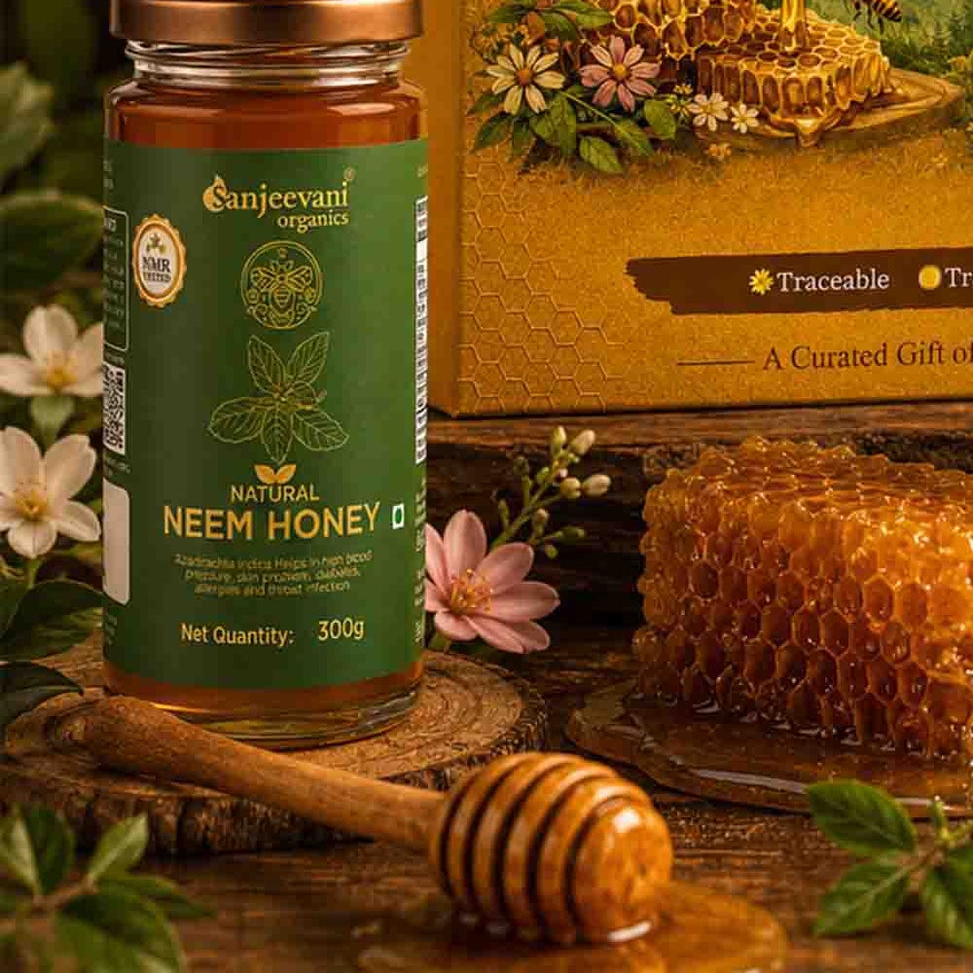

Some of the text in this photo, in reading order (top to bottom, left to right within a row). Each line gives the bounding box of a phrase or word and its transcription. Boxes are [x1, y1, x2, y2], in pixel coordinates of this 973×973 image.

[202, 174, 349, 218] Sanjeevani
[277, 210, 349, 234] organics
[778, 270, 890, 294] Traceable
[763, 347, 782, 371] A
[790, 345, 889, 372] Curated
[896, 338, 944, 367] Gift
[230, 485, 320, 503] NATURAL
[163, 501, 381, 540] NEEM HONEY
[181, 618, 365, 647] Net Quantity: 300g
